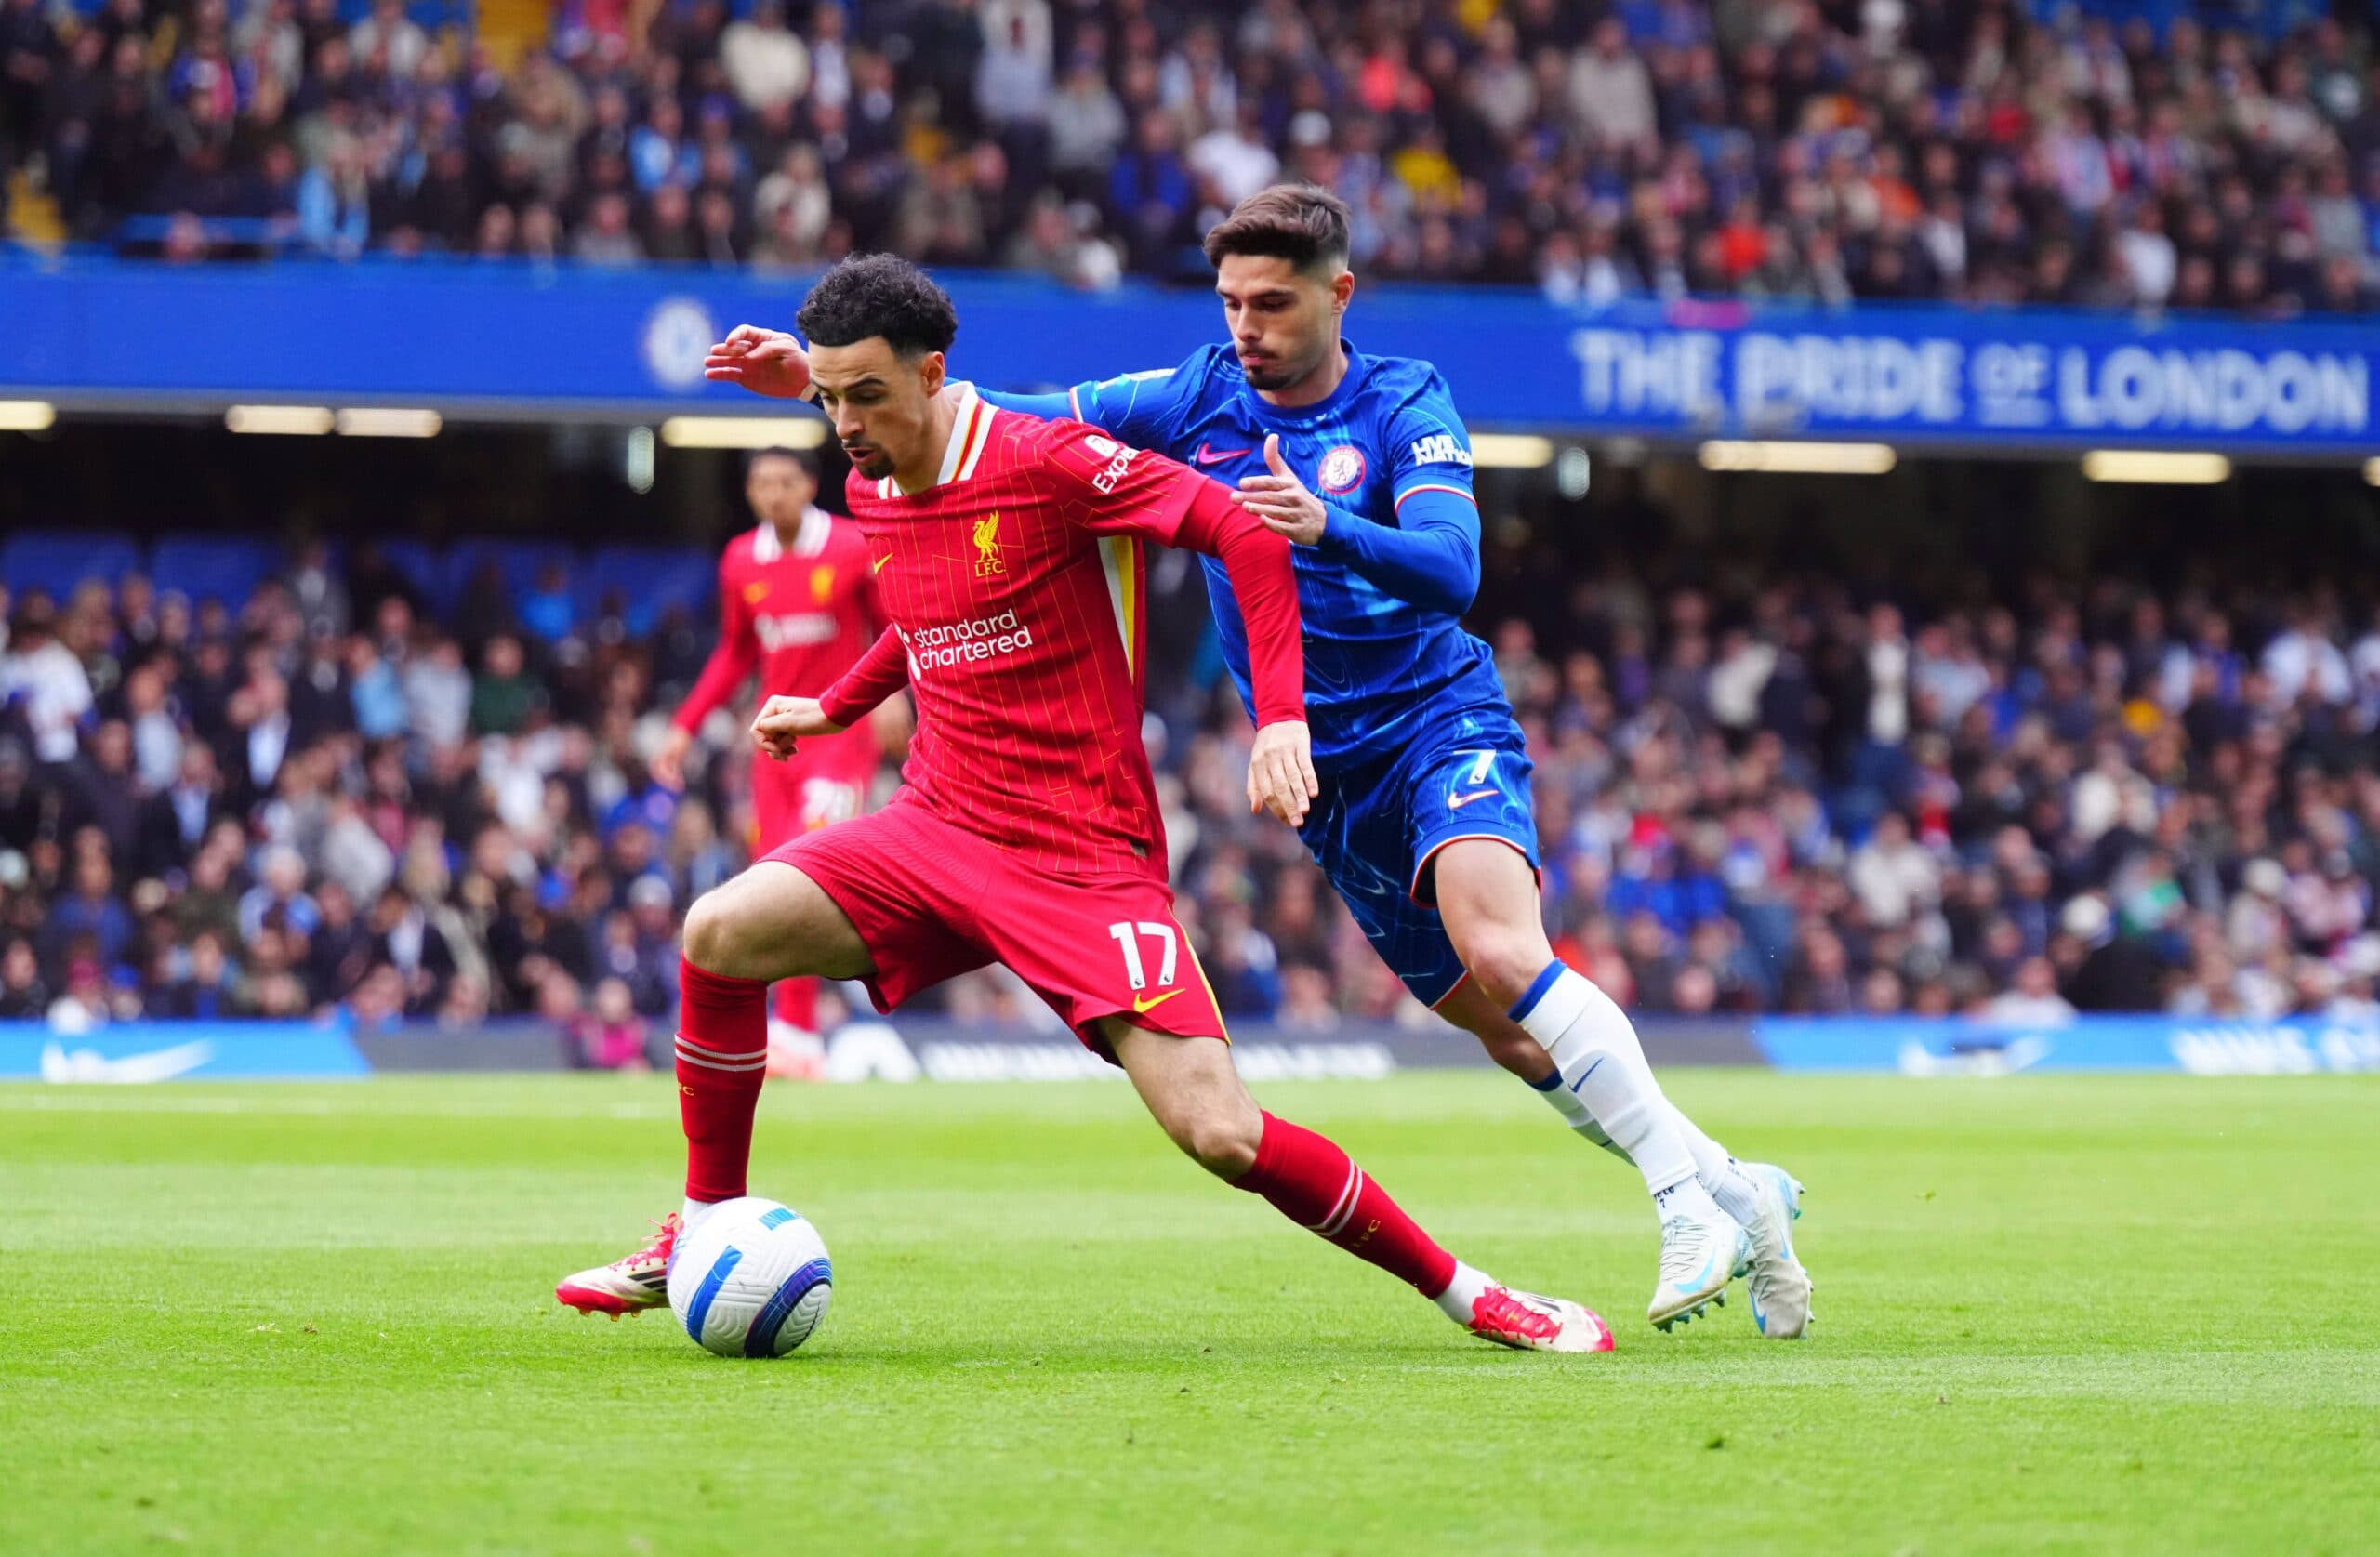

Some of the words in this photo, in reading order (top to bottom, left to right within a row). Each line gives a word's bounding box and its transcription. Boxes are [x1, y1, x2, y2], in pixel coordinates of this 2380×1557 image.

[1569, 330, 1724, 415] THE
[1738, 332, 1965, 422] PRIDE
[2057, 344, 2369, 434] LONDON
[914, 608, 1018, 648] standard
[920, 625, 1033, 670] chartered
[1452, 748, 1497, 785] 7
[1108, 921, 1178, 991] 17
